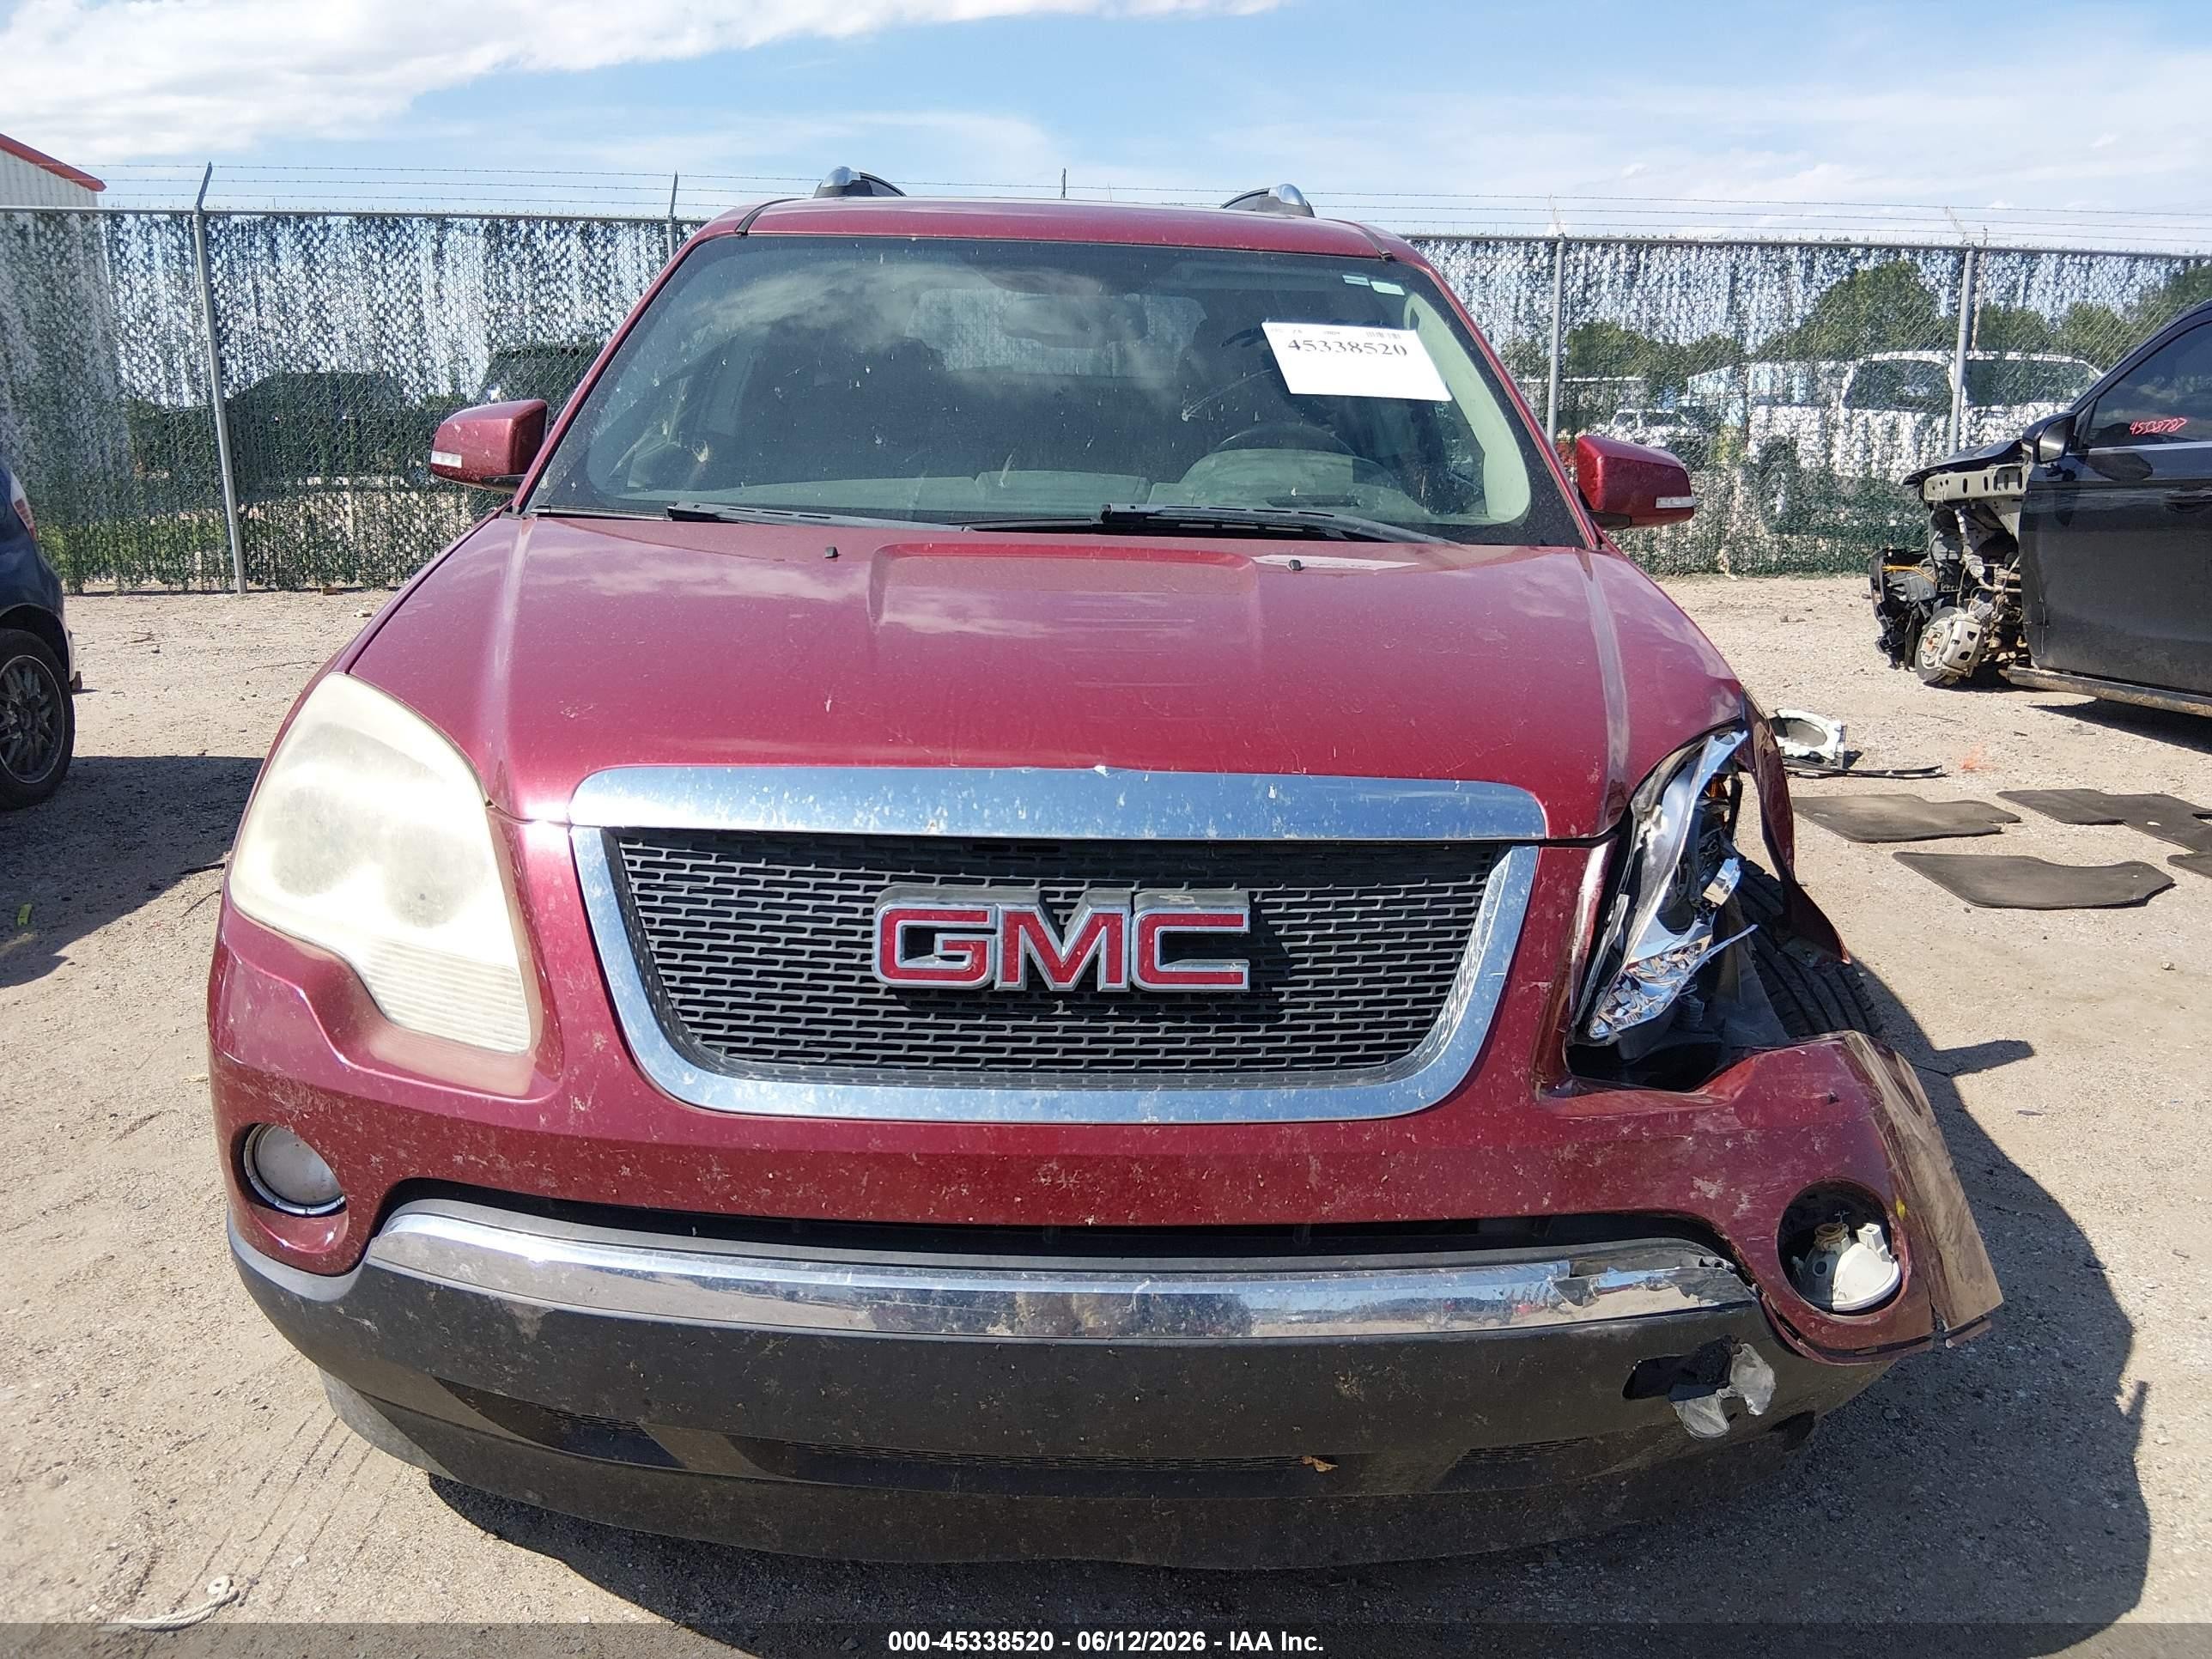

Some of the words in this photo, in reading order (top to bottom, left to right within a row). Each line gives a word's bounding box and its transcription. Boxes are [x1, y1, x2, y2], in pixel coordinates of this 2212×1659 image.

[1287, 338, 1408, 356] 45338520
[2130, 417, 2188, 435] 45338787
[872, 890, 1250, 993] GMC
